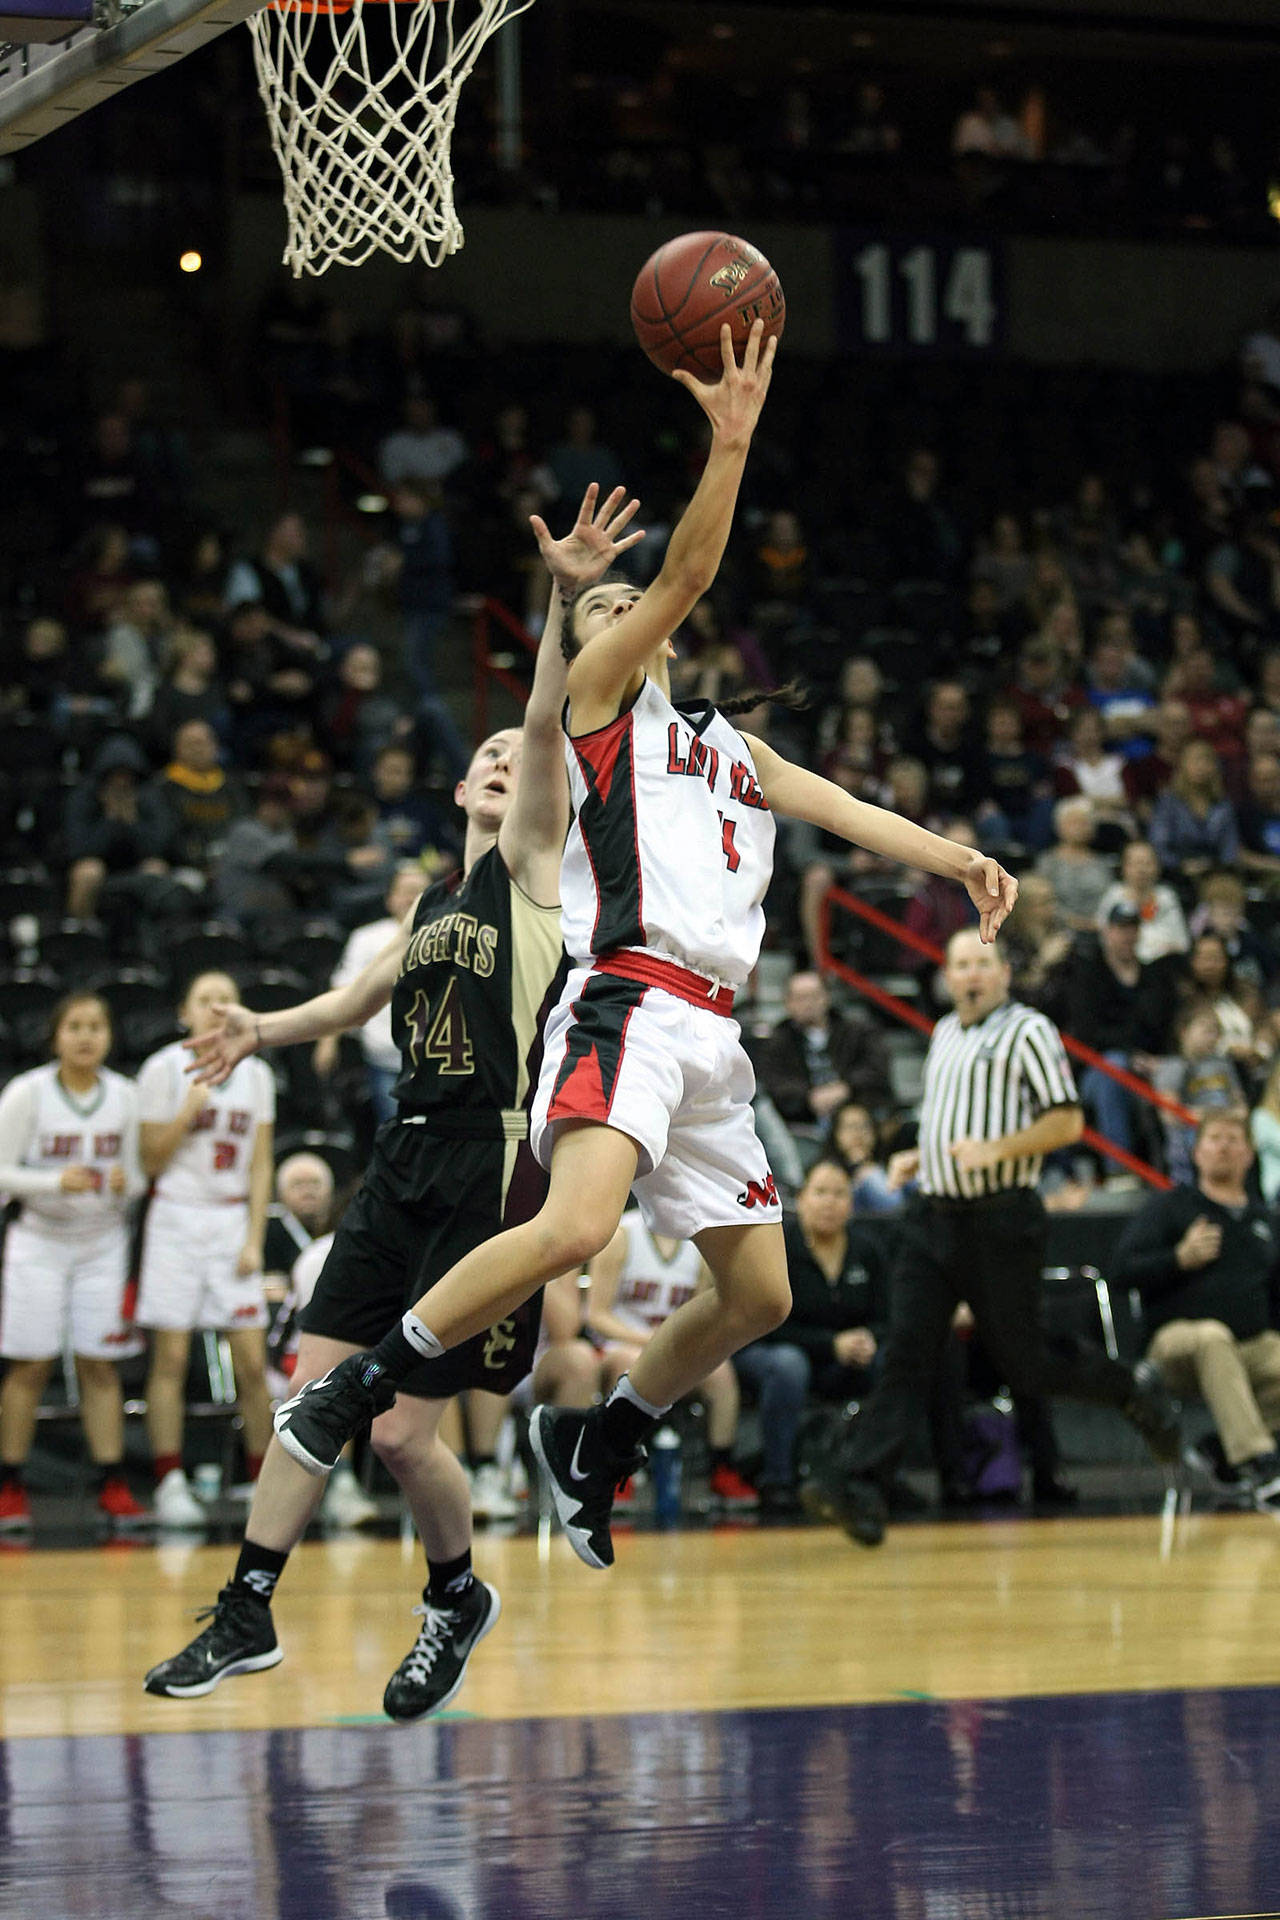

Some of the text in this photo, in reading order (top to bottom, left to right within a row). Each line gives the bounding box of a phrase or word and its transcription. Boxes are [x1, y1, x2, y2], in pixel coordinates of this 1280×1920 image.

[854, 244, 995, 346] 114
[400, 912, 498, 978] IGHTS
[404, 975, 475, 1075] 14
